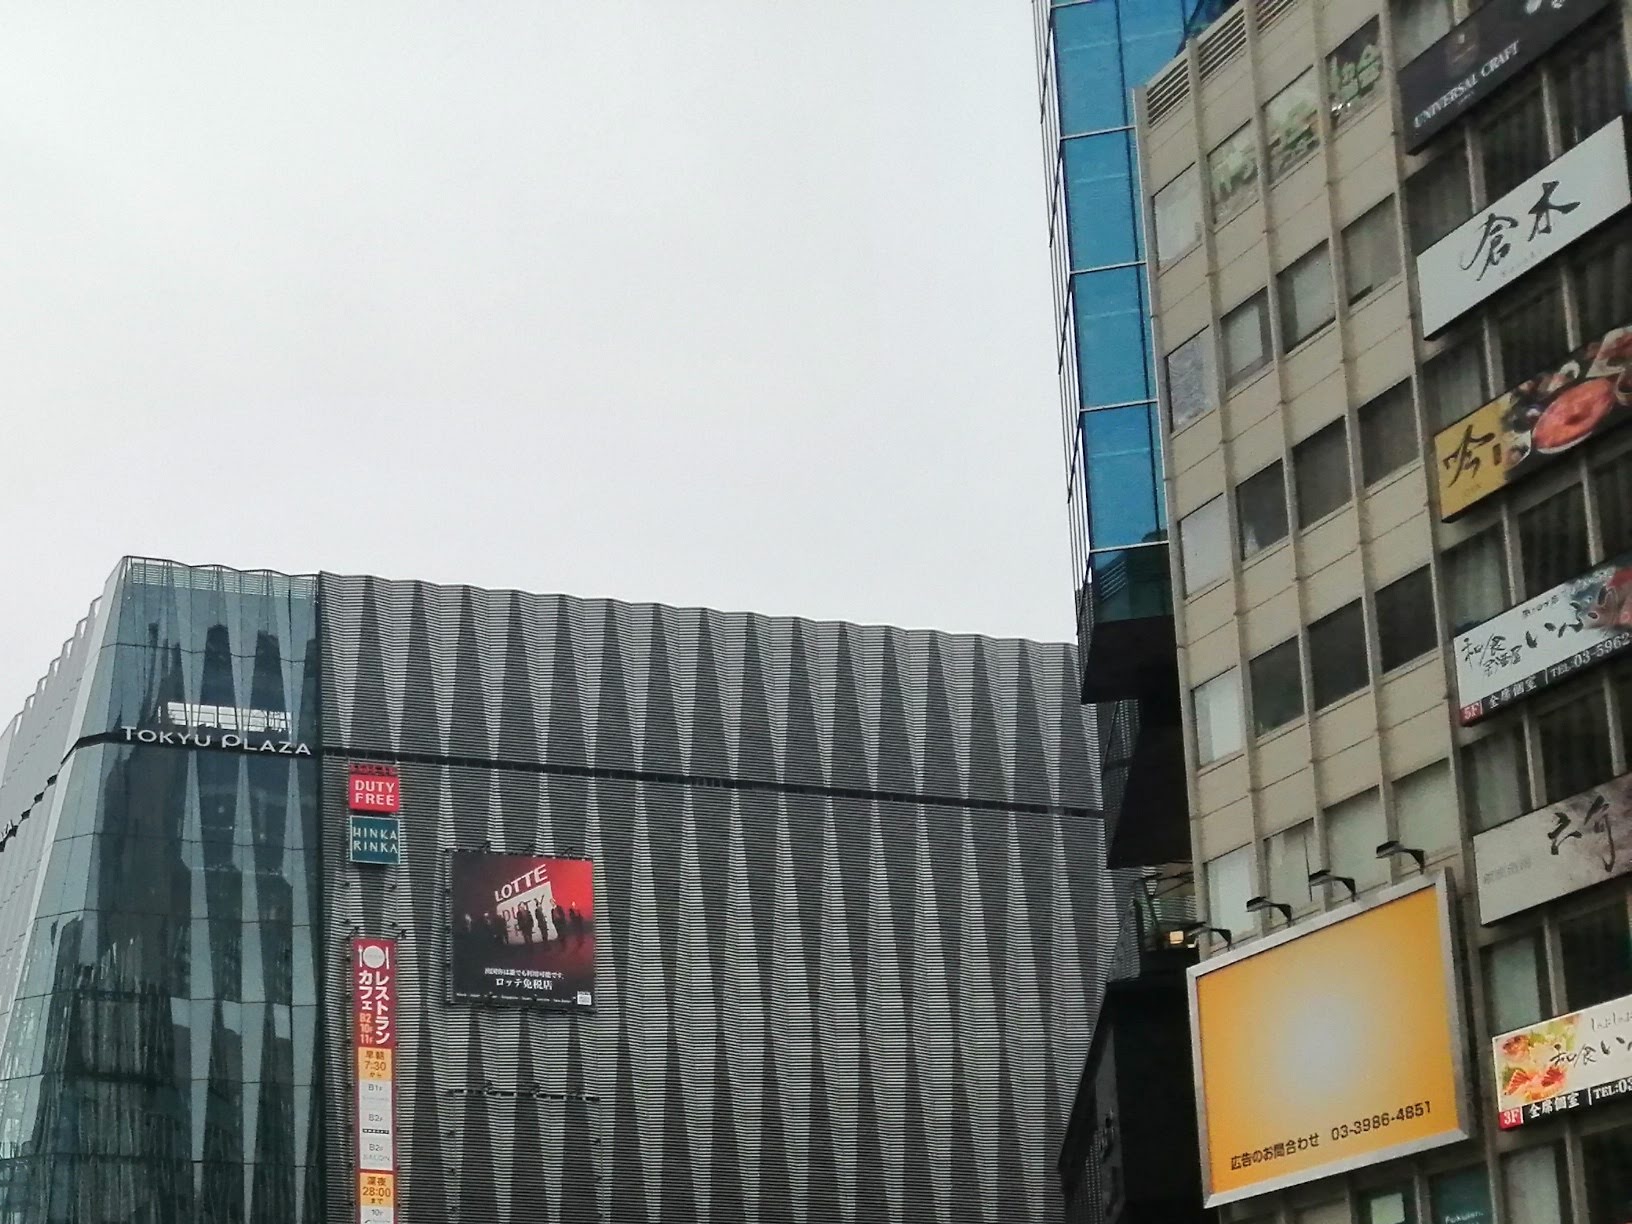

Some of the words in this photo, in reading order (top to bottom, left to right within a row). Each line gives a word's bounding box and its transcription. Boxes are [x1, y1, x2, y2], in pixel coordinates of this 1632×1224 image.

[1464, 702, 1481, 720] 5F
[121, 725, 212, 747] TOKYU
[221, 734, 312, 756] PLAZA
[354, 779, 396, 794] DUTY
[354, 792, 396, 807] FREE
[352, 826, 398, 840] HINKA
[352, 840, 399, 854] RINKA
[494, 863, 549, 903] LOTTE
[358, 969, 374, 1011] カフェ
[495, 977, 554, 991] ロッテ免税店
[375, 970, 391, 1045] レストラン
[1528, 1091, 1581, 1119] 全席個室
[1503, 1108, 1521, 1125] 3F
[1230, 1133, 1321, 1171] 広告のお問合わせ
[1330, 1100, 1433, 1141] 03-3986-4851
[362, 1186, 391, 1198] 28:00
